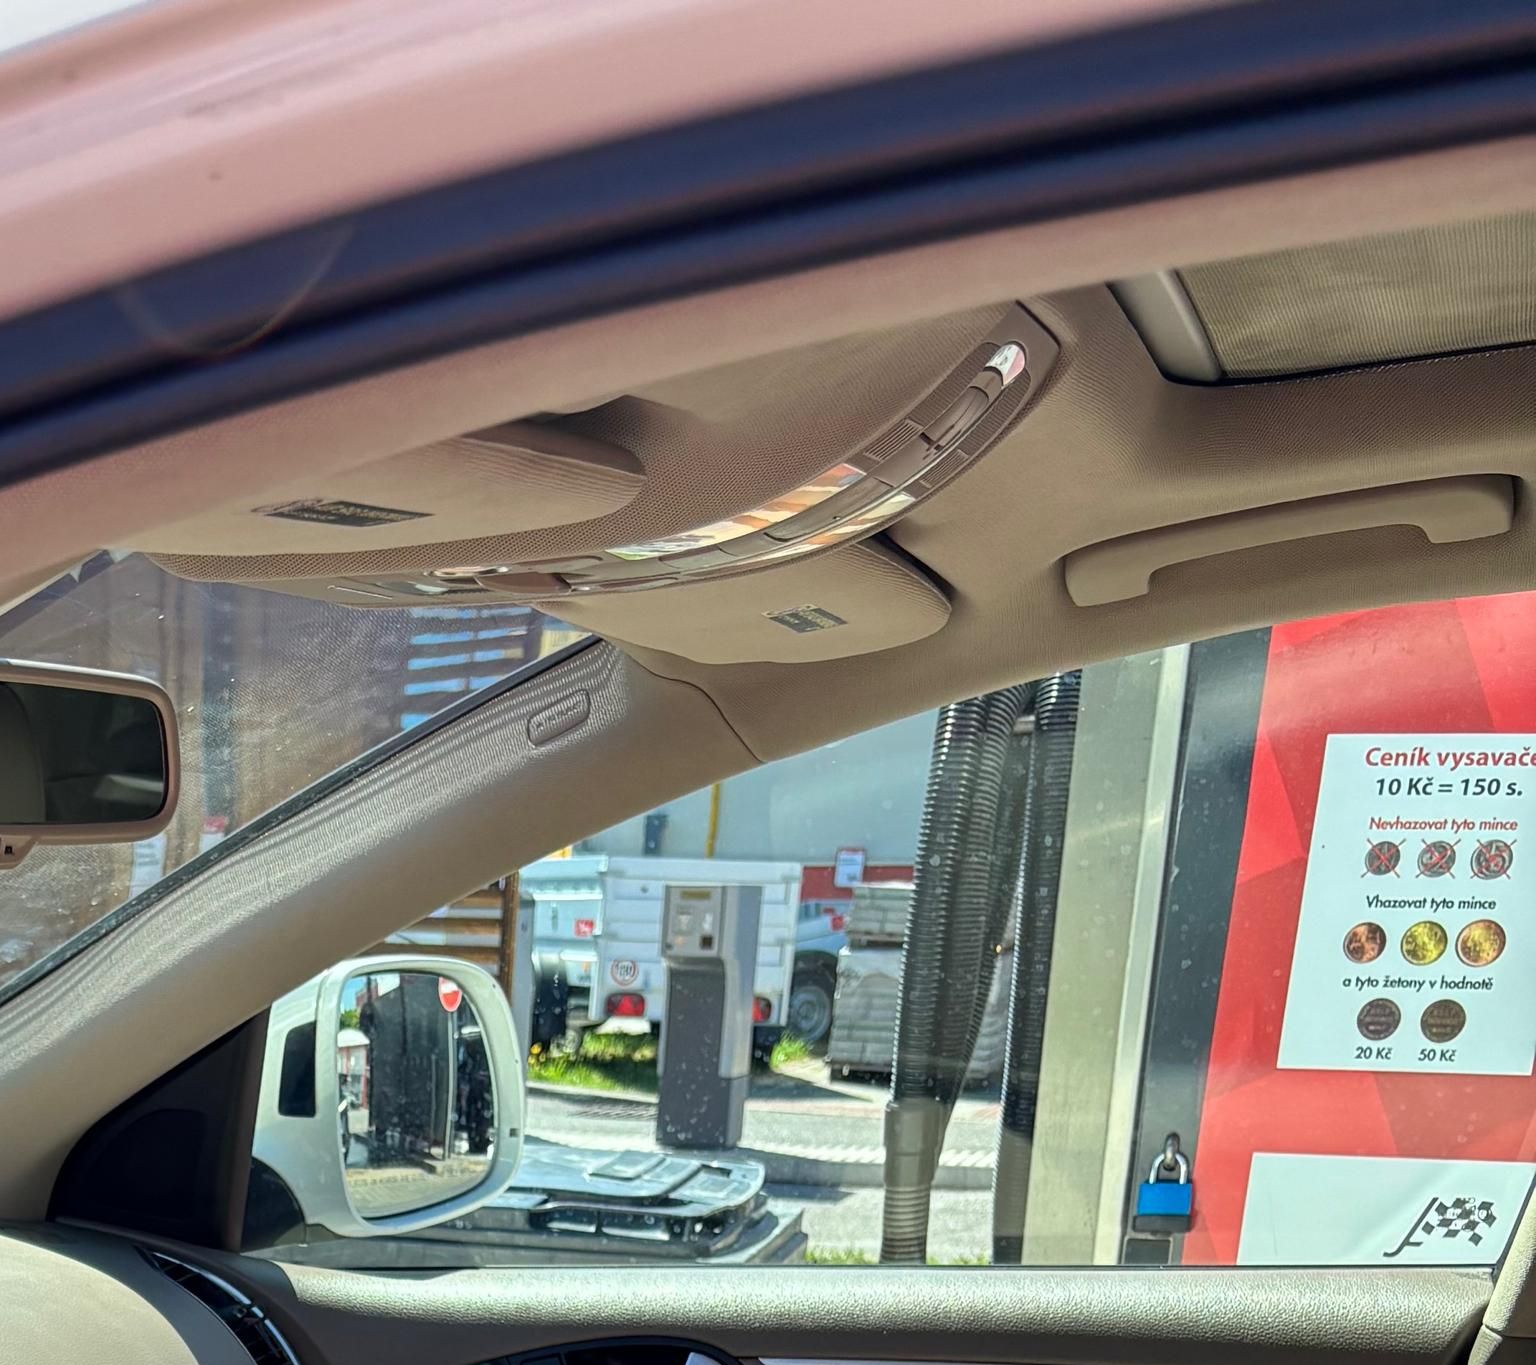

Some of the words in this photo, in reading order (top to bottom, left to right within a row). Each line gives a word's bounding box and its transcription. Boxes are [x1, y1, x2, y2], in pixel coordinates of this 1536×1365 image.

[1365, 747, 1431, 767] Ceník
[1376, 778, 1402, 796] 10
[1407, 776, 1434, 796] Kč
[1438, 783, 1453, 793] =
[1460, 778, 1501, 796] 150
[1505, 781, 1523, 796] s.
[1369, 816, 1448, 831] Nevhazovat
[1451, 818, 1475, 834] tyto
[1479, 817, 1519, 831] mince
[1366, 894, 1427, 909] Vhazovat
[1430, 896, 1454, 913] tyto
[1458, 896, 1496, 910] mince
[1342, 977, 1352, 988] a
[1355, 976, 1379, 991] tyto
[1382, 975, 1425, 993] žetony
[1429, 980, 1437, 989] v
[1440, 975, 1494, 990] hodnotě
[1354, 1046, 1372, 1060] 20
[1376, 1046, 1393, 1060] Kč
[1418, 1048, 1436, 1062] 50
[1439, 1048, 1457, 1062] Kč
